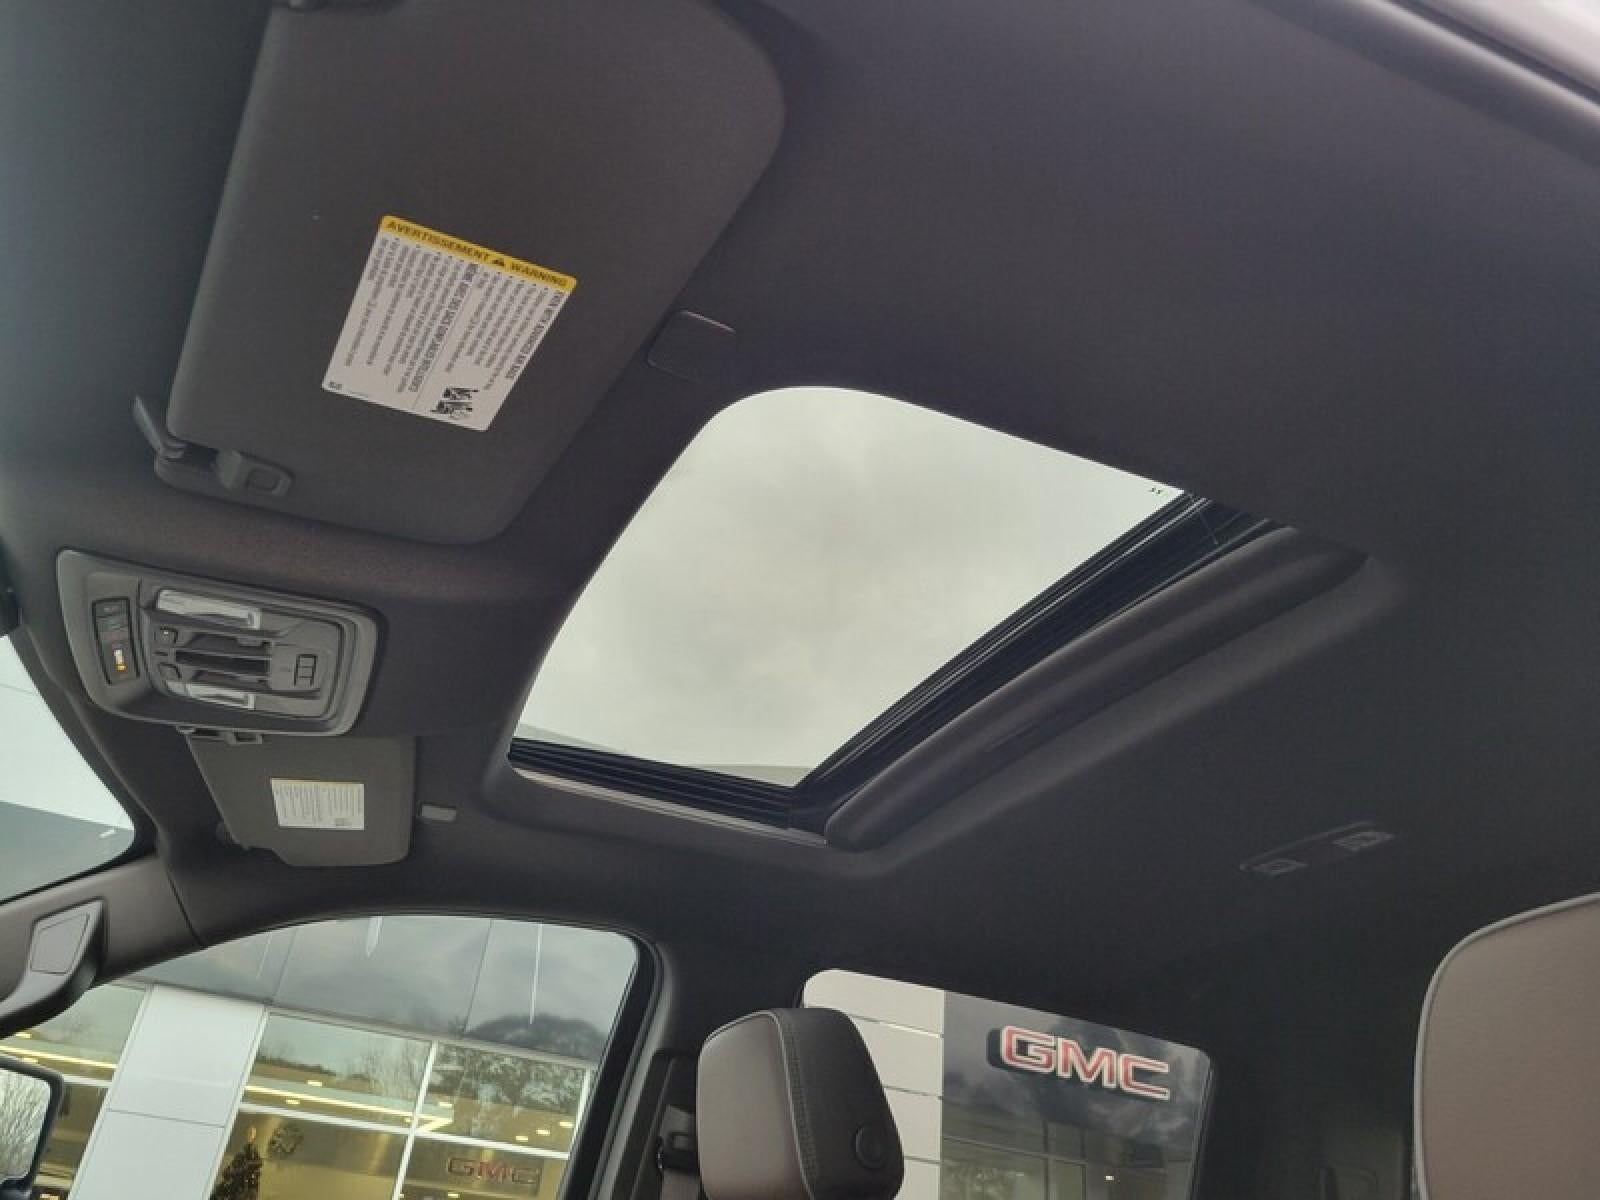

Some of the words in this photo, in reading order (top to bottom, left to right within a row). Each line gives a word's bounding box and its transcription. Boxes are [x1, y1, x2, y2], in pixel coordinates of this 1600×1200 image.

[387, 220, 490, 261] AVERTISSEMENT
[511, 262, 568, 287] WARNING
[1001, 1025, 1170, 1101] GMC
[447, 1157, 537, 1185] GMC
